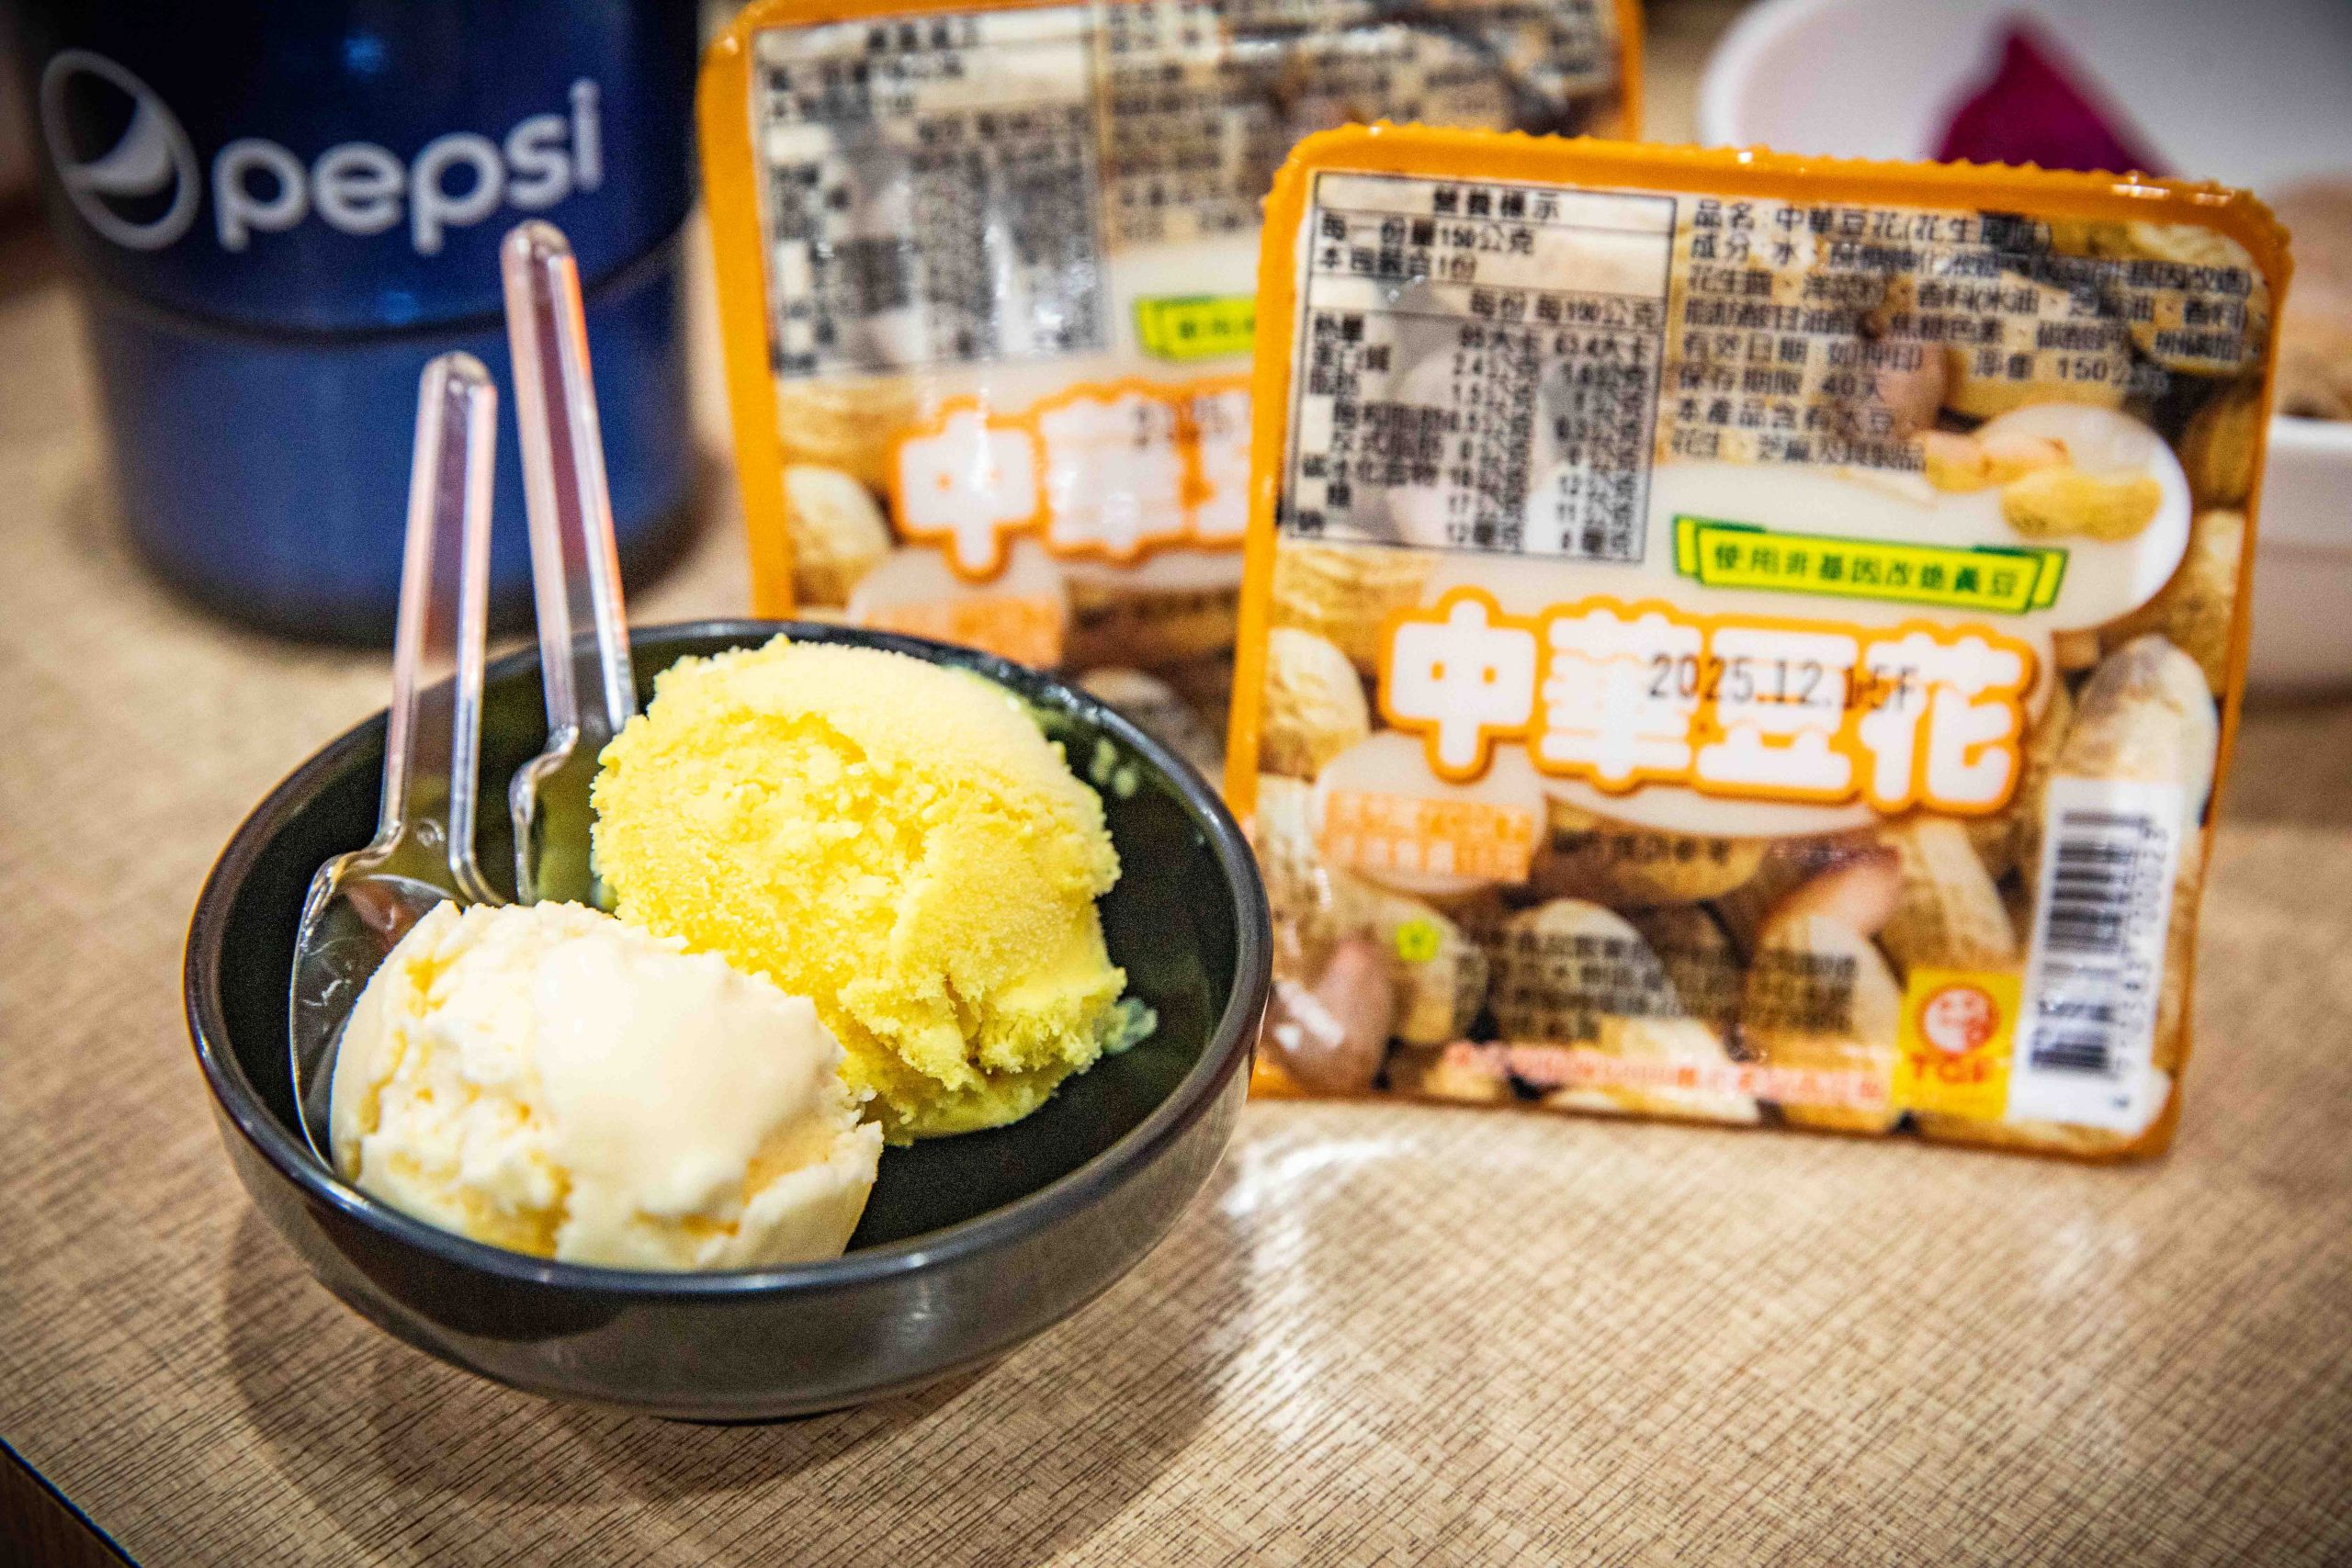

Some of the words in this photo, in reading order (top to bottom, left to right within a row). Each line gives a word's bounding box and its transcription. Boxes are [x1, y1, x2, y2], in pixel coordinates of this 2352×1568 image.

[211, 78, 603, 254] pepsi
[1384, 592, 2033, 814] 中華豆花
